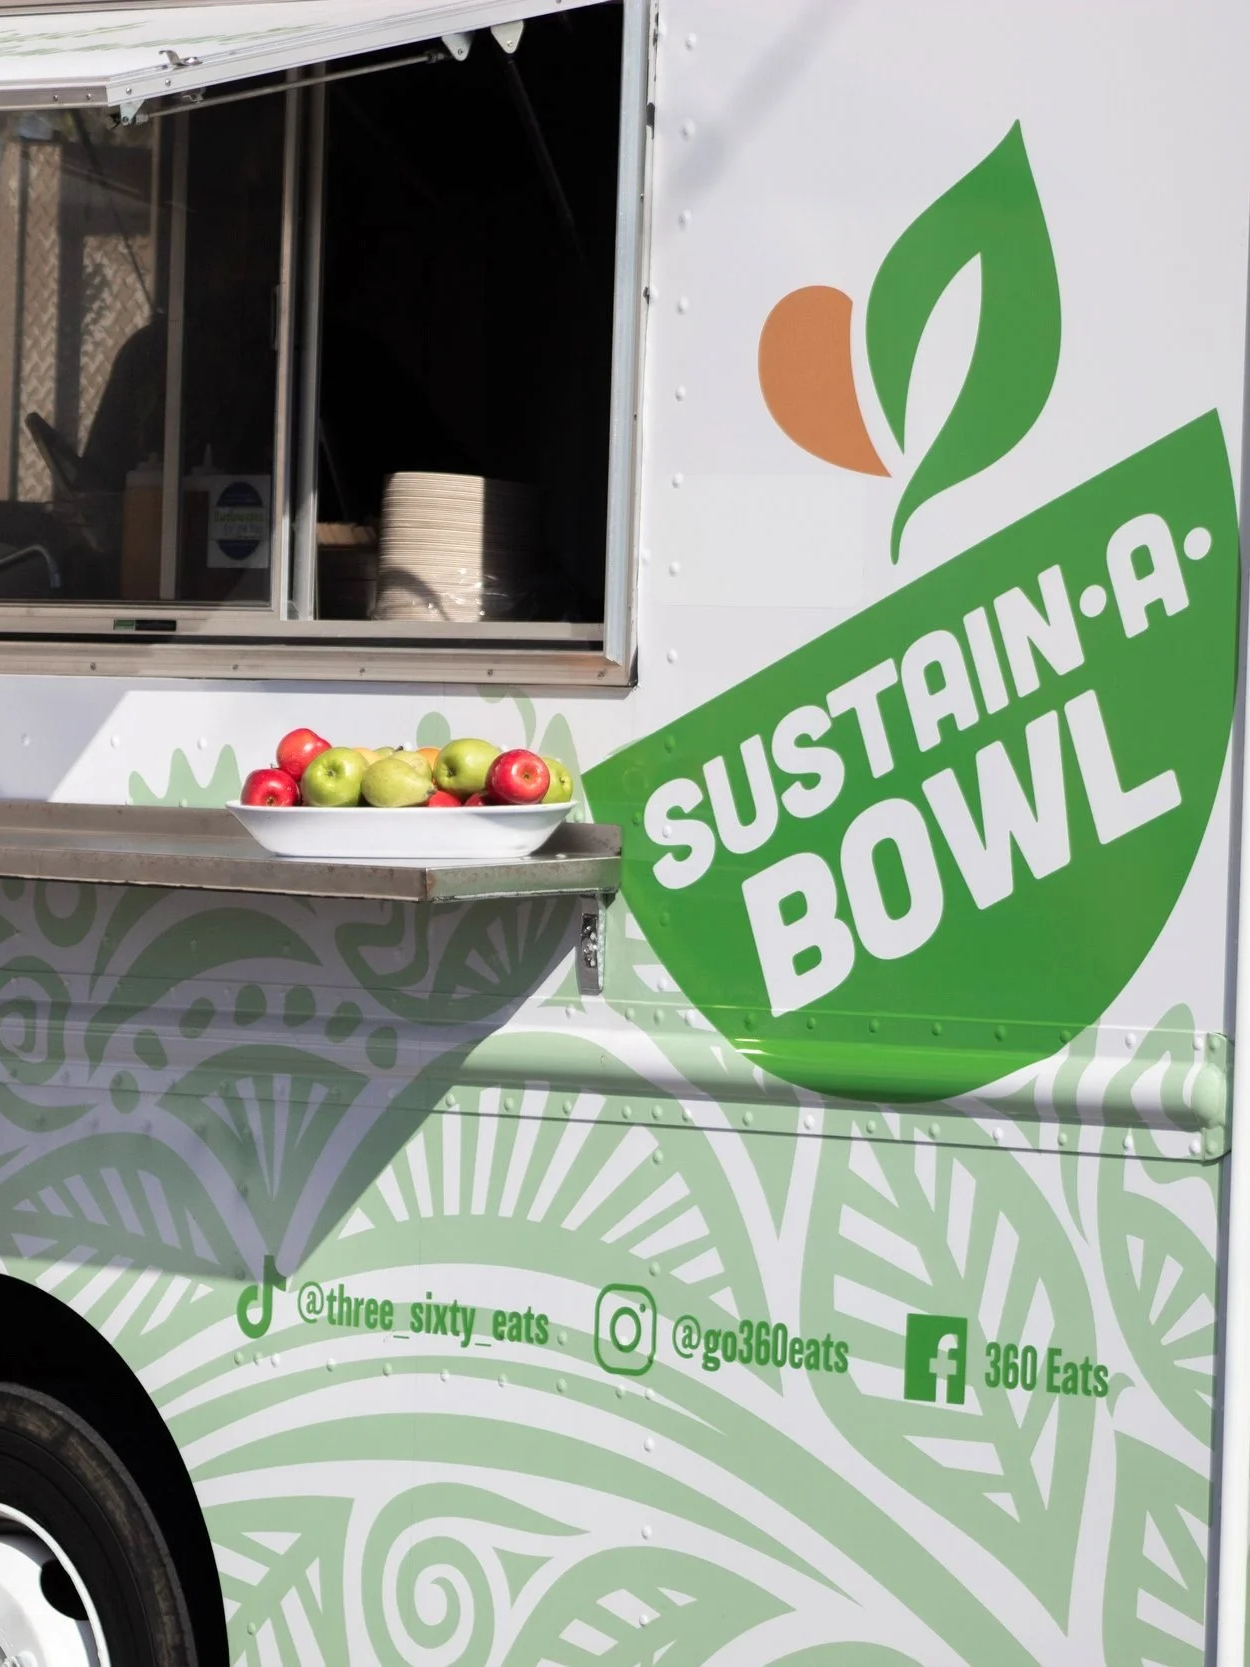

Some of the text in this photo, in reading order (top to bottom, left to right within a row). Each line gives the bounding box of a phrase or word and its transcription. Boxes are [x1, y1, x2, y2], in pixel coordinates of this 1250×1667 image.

[742, 690, 1181, 1017] BOWL
[672, 1314, 850, 1374] @go360eats
[984, 1341, 1109, 1398] 360 Eats
